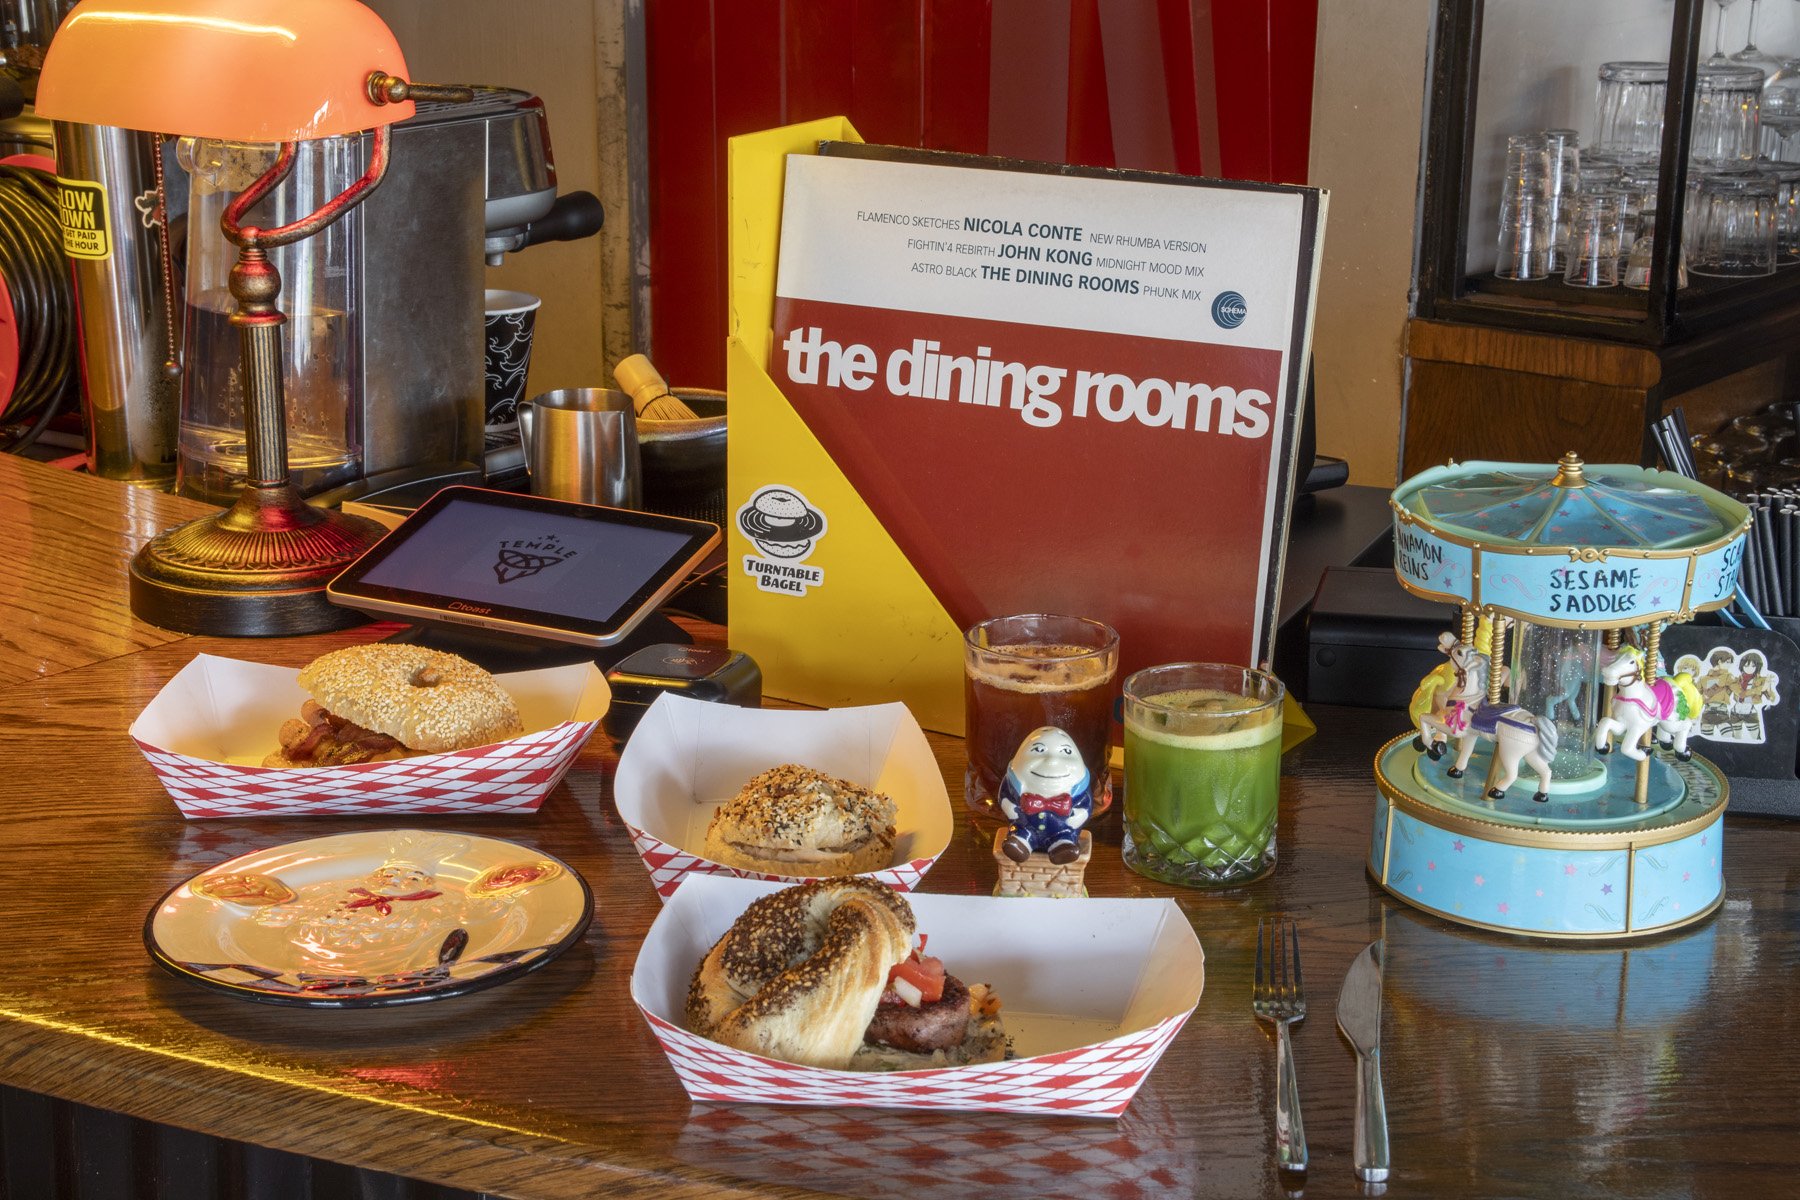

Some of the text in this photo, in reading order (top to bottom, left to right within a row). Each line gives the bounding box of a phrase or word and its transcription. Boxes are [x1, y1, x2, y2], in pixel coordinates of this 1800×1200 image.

[60, 188, 94, 211] LOW
[61, 208, 96, 230] OWN
[78, 230, 97, 240] PAID
[856, 211, 1207, 254] FLAMENCO SKETCHES NICOLA CONTE NEW RHUMBA VERSION
[76, 241, 99, 251] HOUR
[907, 238, 1205, 277] FIGHTIN'4 REBIRTH JOHN KONG MIDNIGHT MOOD MIX
[911, 262, 1201, 301] ASTRO BLACK THE DINING ROOMS PHUNK MIX
[1220, 306, 1247, 316] SCHEMA
[783, 327, 1271, 438] the dining rooms
[500, 540, 578, 560] TEMPLE
[746, 559, 820, 582] TURNTABLE
[1550, 567, 1641, 590] SESAME
[761, 575, 803, 592] BAGEL
[460, 603, 492, 616] toast
[1549, 594, 1637, 613] SADDLES
